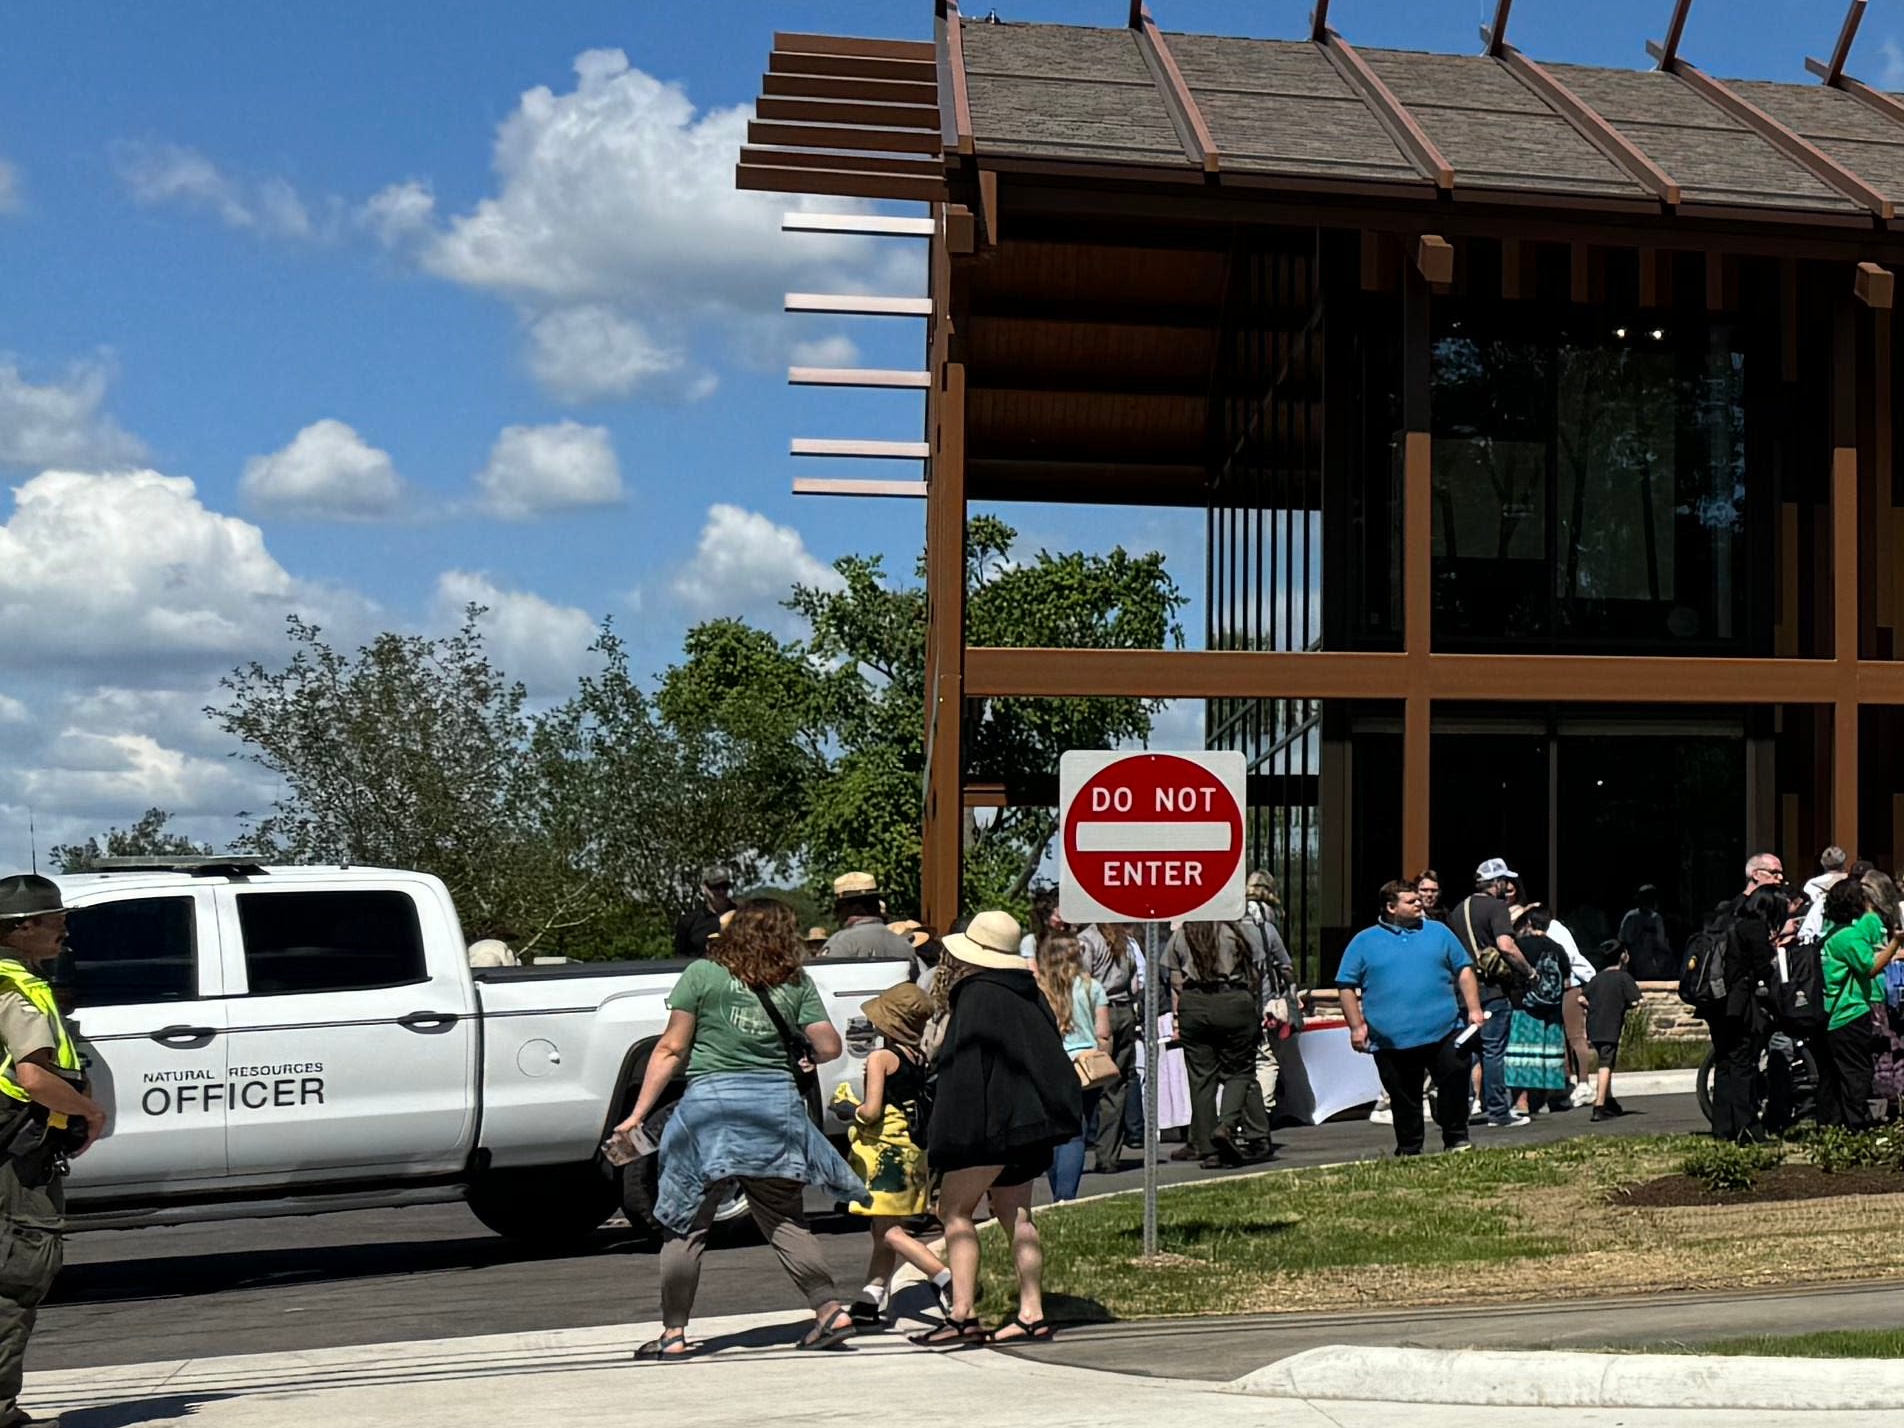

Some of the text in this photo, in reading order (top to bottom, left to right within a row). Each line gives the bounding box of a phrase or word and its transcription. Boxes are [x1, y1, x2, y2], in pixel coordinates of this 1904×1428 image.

[1092, 787, 1217, 812] DO NOT
[1103, 861, 1203, 886] ENTER
[143, 1062, 324, 1083] NATURAL RESOURCES
[141, 1077, 325, 1116] OFFICER
